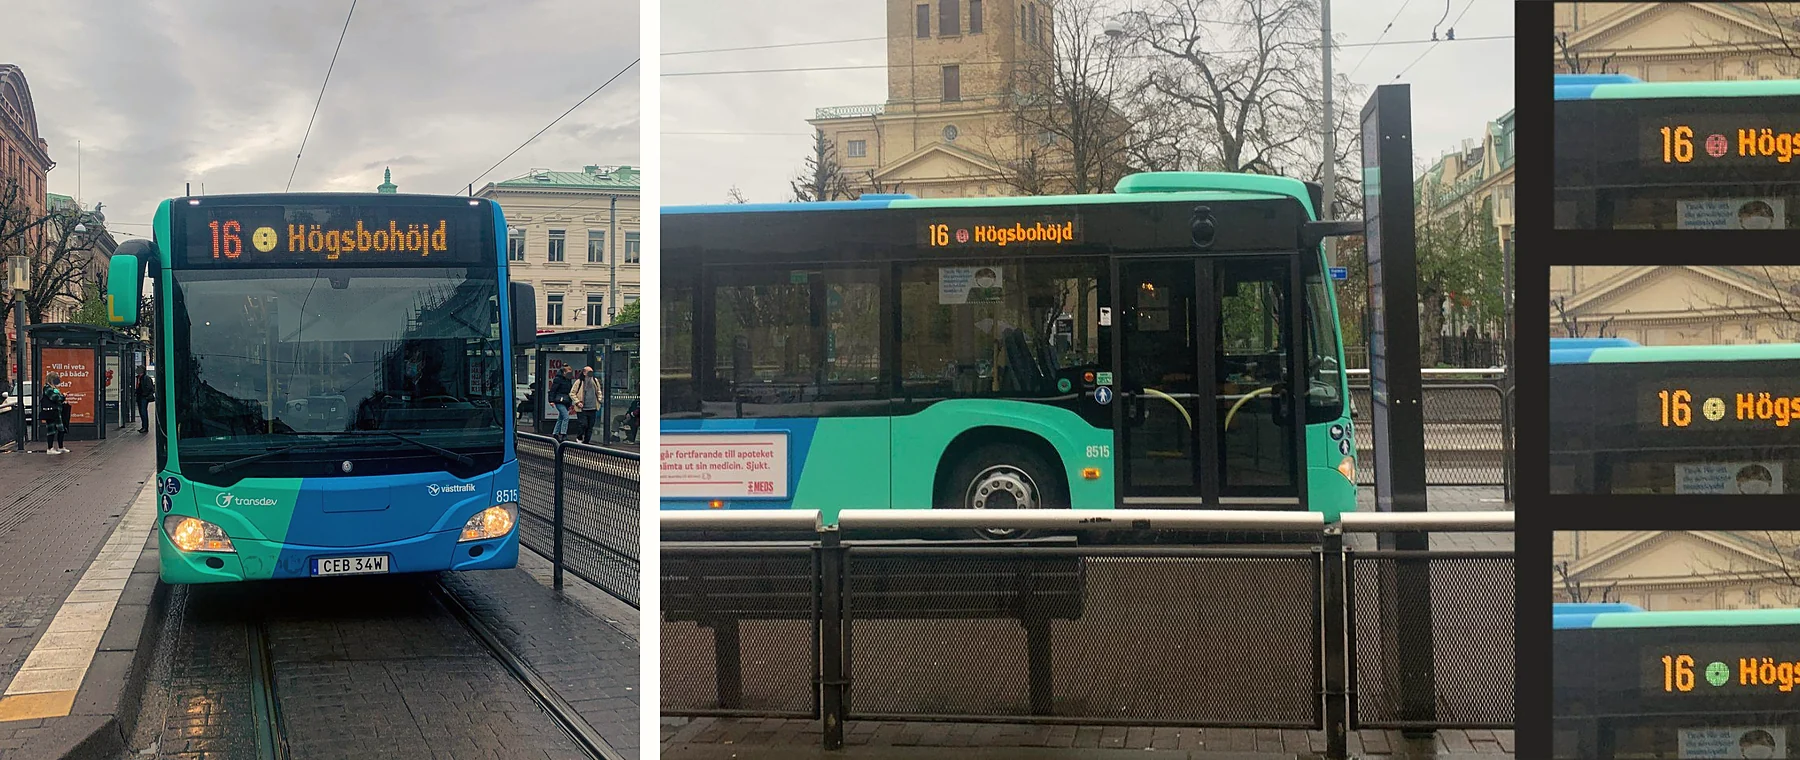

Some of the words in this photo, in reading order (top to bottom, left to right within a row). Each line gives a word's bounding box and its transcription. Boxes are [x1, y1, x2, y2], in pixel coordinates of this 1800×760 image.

[1660, 125, 1694, 163] 16
[209, 220, 242, 259] 16
[288, 220, 447, 260] Högsbohöjd
[929, 224, 949, 247] 16
[974, 221, 1073, 246] Högsbohöjd
[1658, 389, 1692, 427] 16
[660, 450, 674, 460] går
[675, 449, 723, 459] fortfarande
[724, 449, 736, 458] till
[737, 449, 774, 460] apoteket
[1086, 445, 1110, 458] 8515
[684, 462, 694, 470] ut
[695, 461, 708, 470] sin
[709, 461, 744, 470] medicin.
[746, 461, 771, 472] Sjukt.
[441, 483, 476, 493] västtrafik
[753, 481, 774, 492] MEDS
[235, 497, 278, 506] transdev
[496, 489, 518, 503] 8515
[323, 559, 351, 573] CEB
[355, 557, 383, 571] 34W
[1661, 654, 1696, 692] 16
